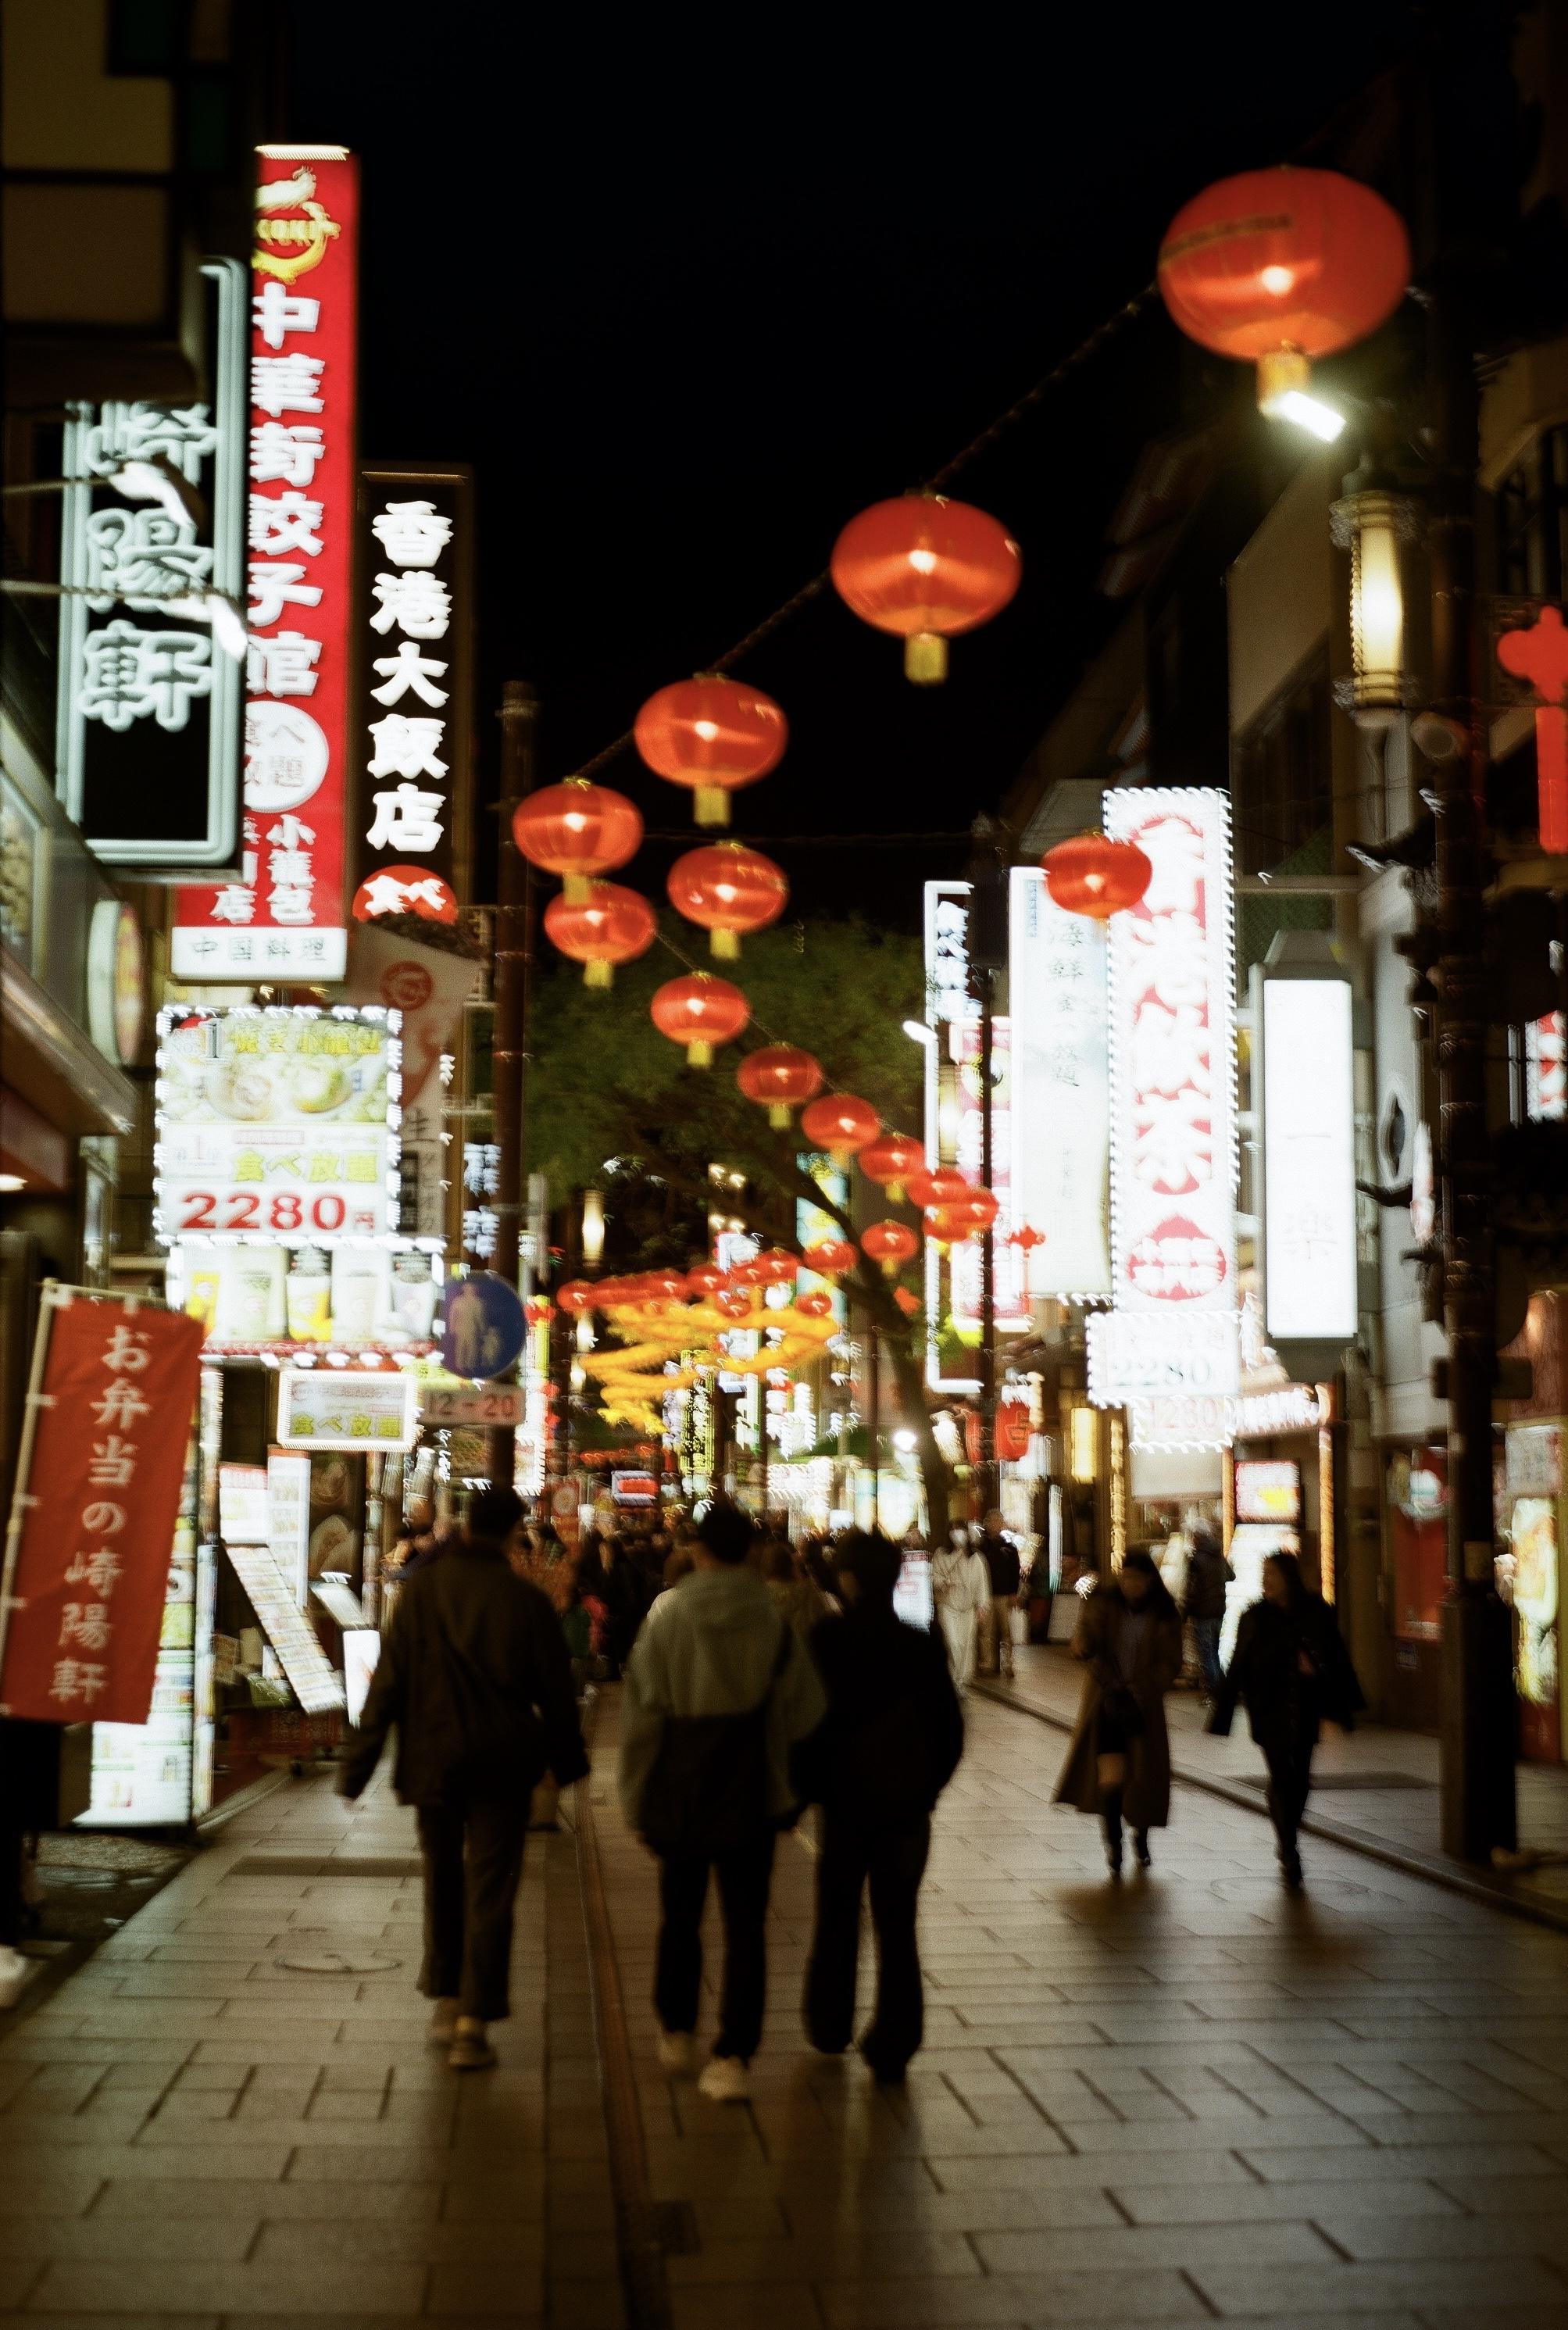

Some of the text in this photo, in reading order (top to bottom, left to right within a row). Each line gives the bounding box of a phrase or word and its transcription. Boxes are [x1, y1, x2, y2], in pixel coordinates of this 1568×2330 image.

[247, 282, 326, 698] 中華街餃子館
[366, 500, 453, 852] 香港大飯店
[266, 814, 316, 925] 小籠包
[363, 874, 447, 917] 食べ
[193, 935, 327, 961] 中国料理
[233, 1148, 379, 1184] 食べ放題
[291, 1413, 402, 1438] 食べ放題
[48, 1325, 154, 1705] お弁当の崎陽軒
